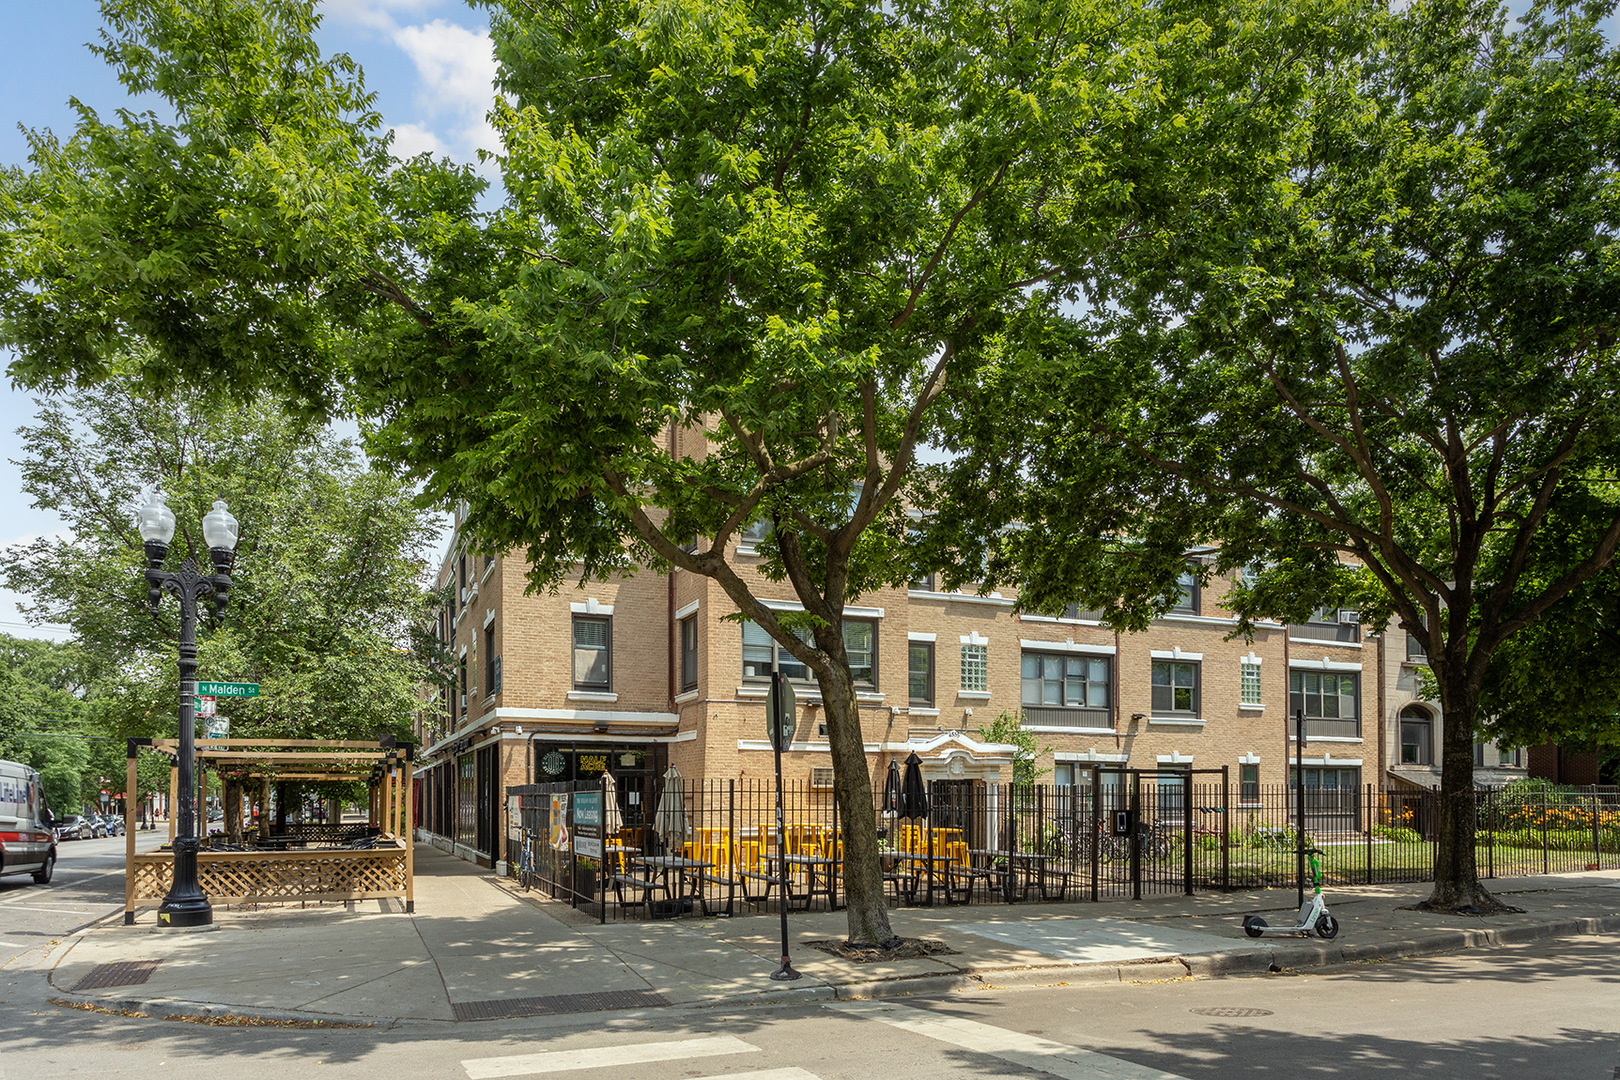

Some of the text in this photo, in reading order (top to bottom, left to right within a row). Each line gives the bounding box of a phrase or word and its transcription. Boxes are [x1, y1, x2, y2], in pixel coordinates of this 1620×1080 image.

[209, 684, 245, 695] Malden
[580, 762, 606, 771] ACRE
[584, 806, 598, 822] Leasing
